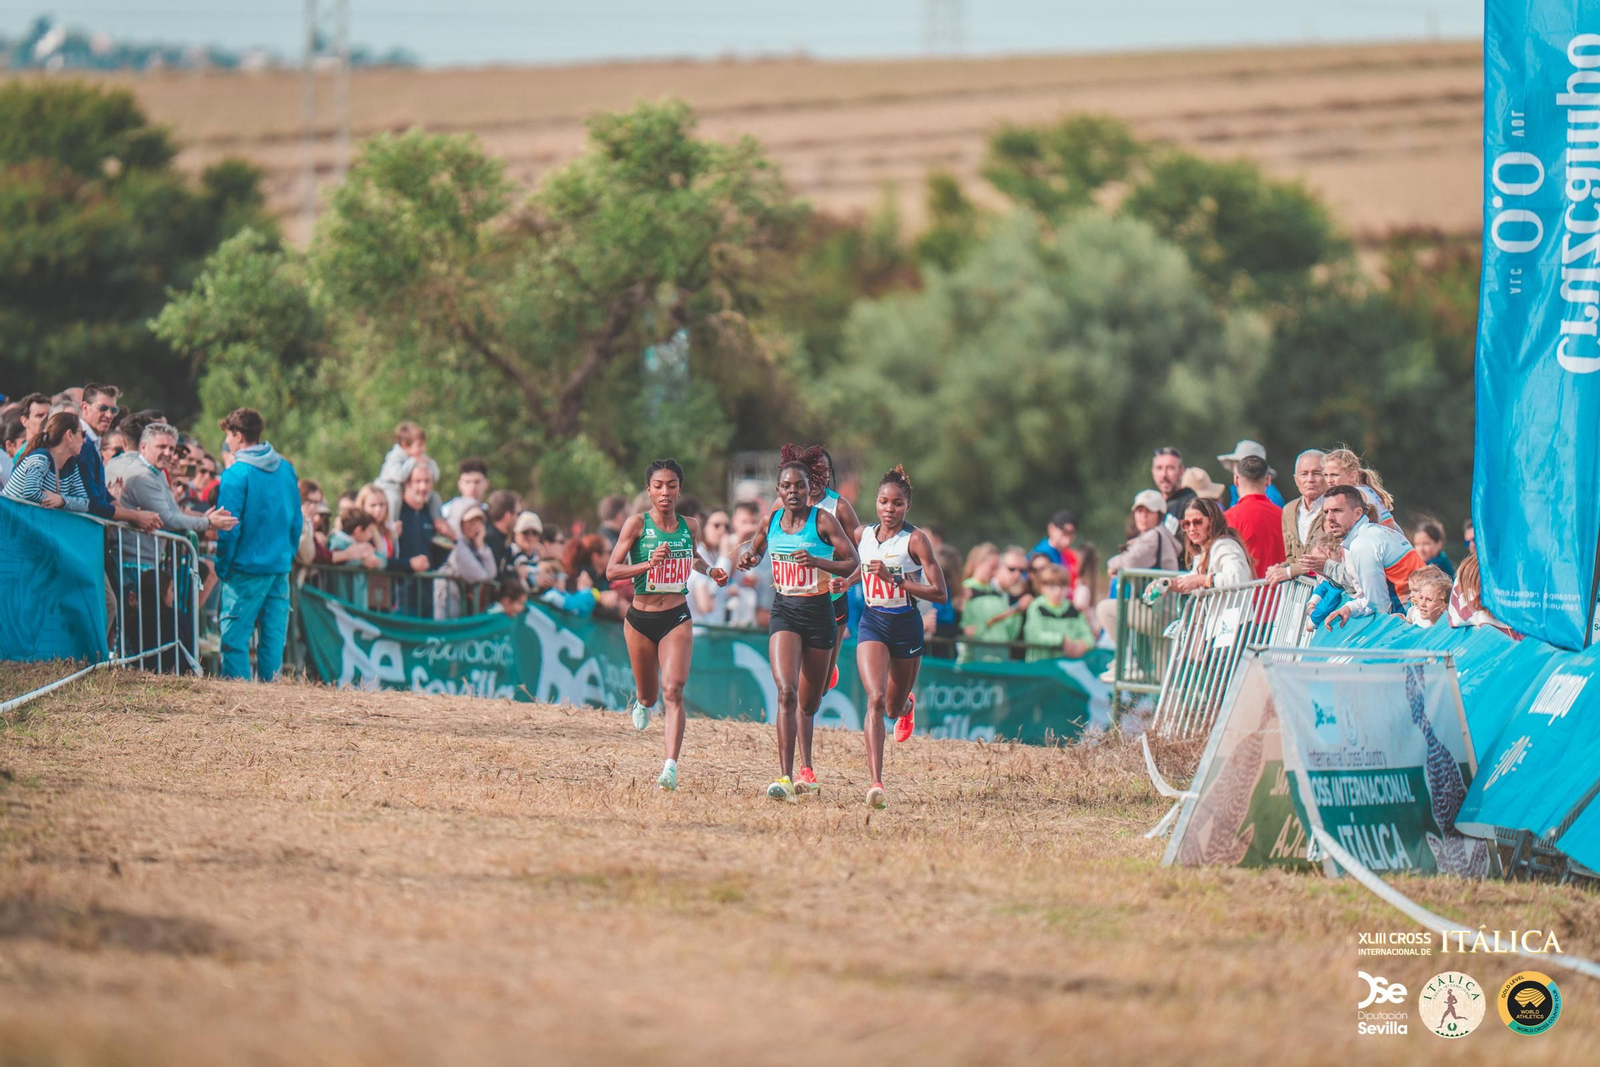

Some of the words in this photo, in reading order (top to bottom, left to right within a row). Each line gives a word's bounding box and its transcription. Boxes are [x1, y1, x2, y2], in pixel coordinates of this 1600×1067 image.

[772, 561, 813, 587] BIWOT
[1311, 776, 1333, 806] OSS
[1331, 773, 1416, 807] INTERNACIONAL
